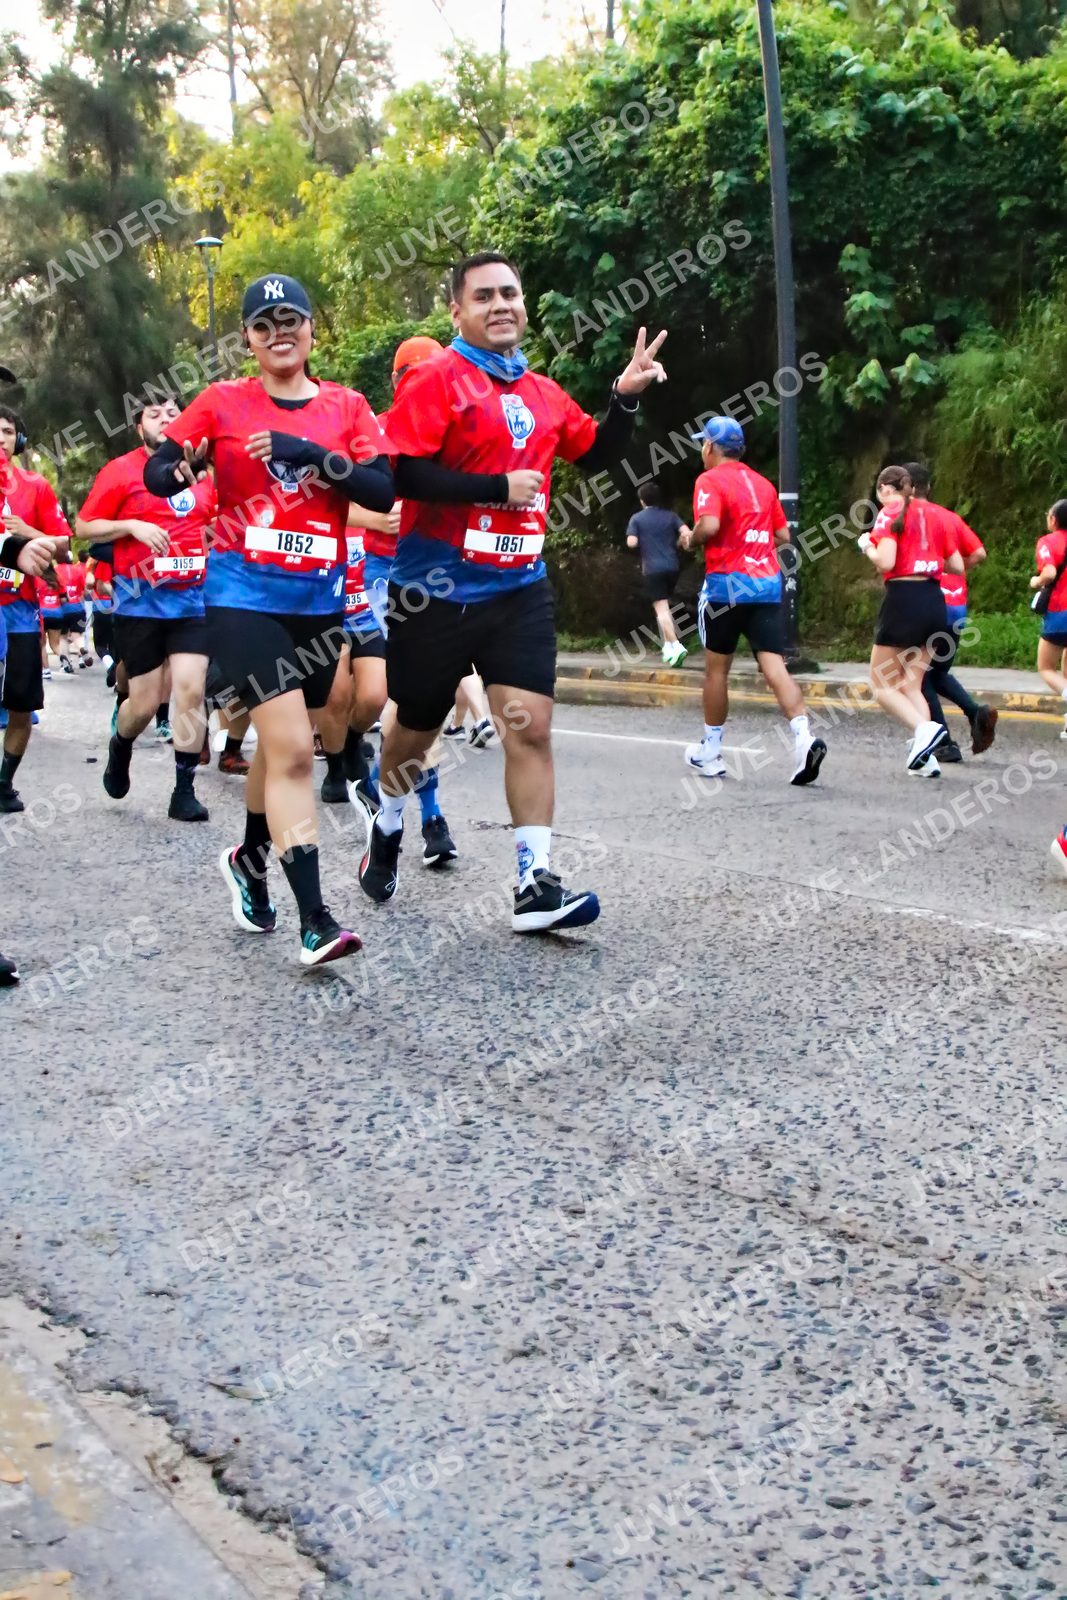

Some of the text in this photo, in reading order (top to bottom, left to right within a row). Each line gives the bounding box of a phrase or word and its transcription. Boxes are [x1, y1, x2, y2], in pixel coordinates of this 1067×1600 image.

[277, 532, 314, 555] 1852
[495, 535, 524, 553] 1851
[173, 558, 194, 569] 3159
